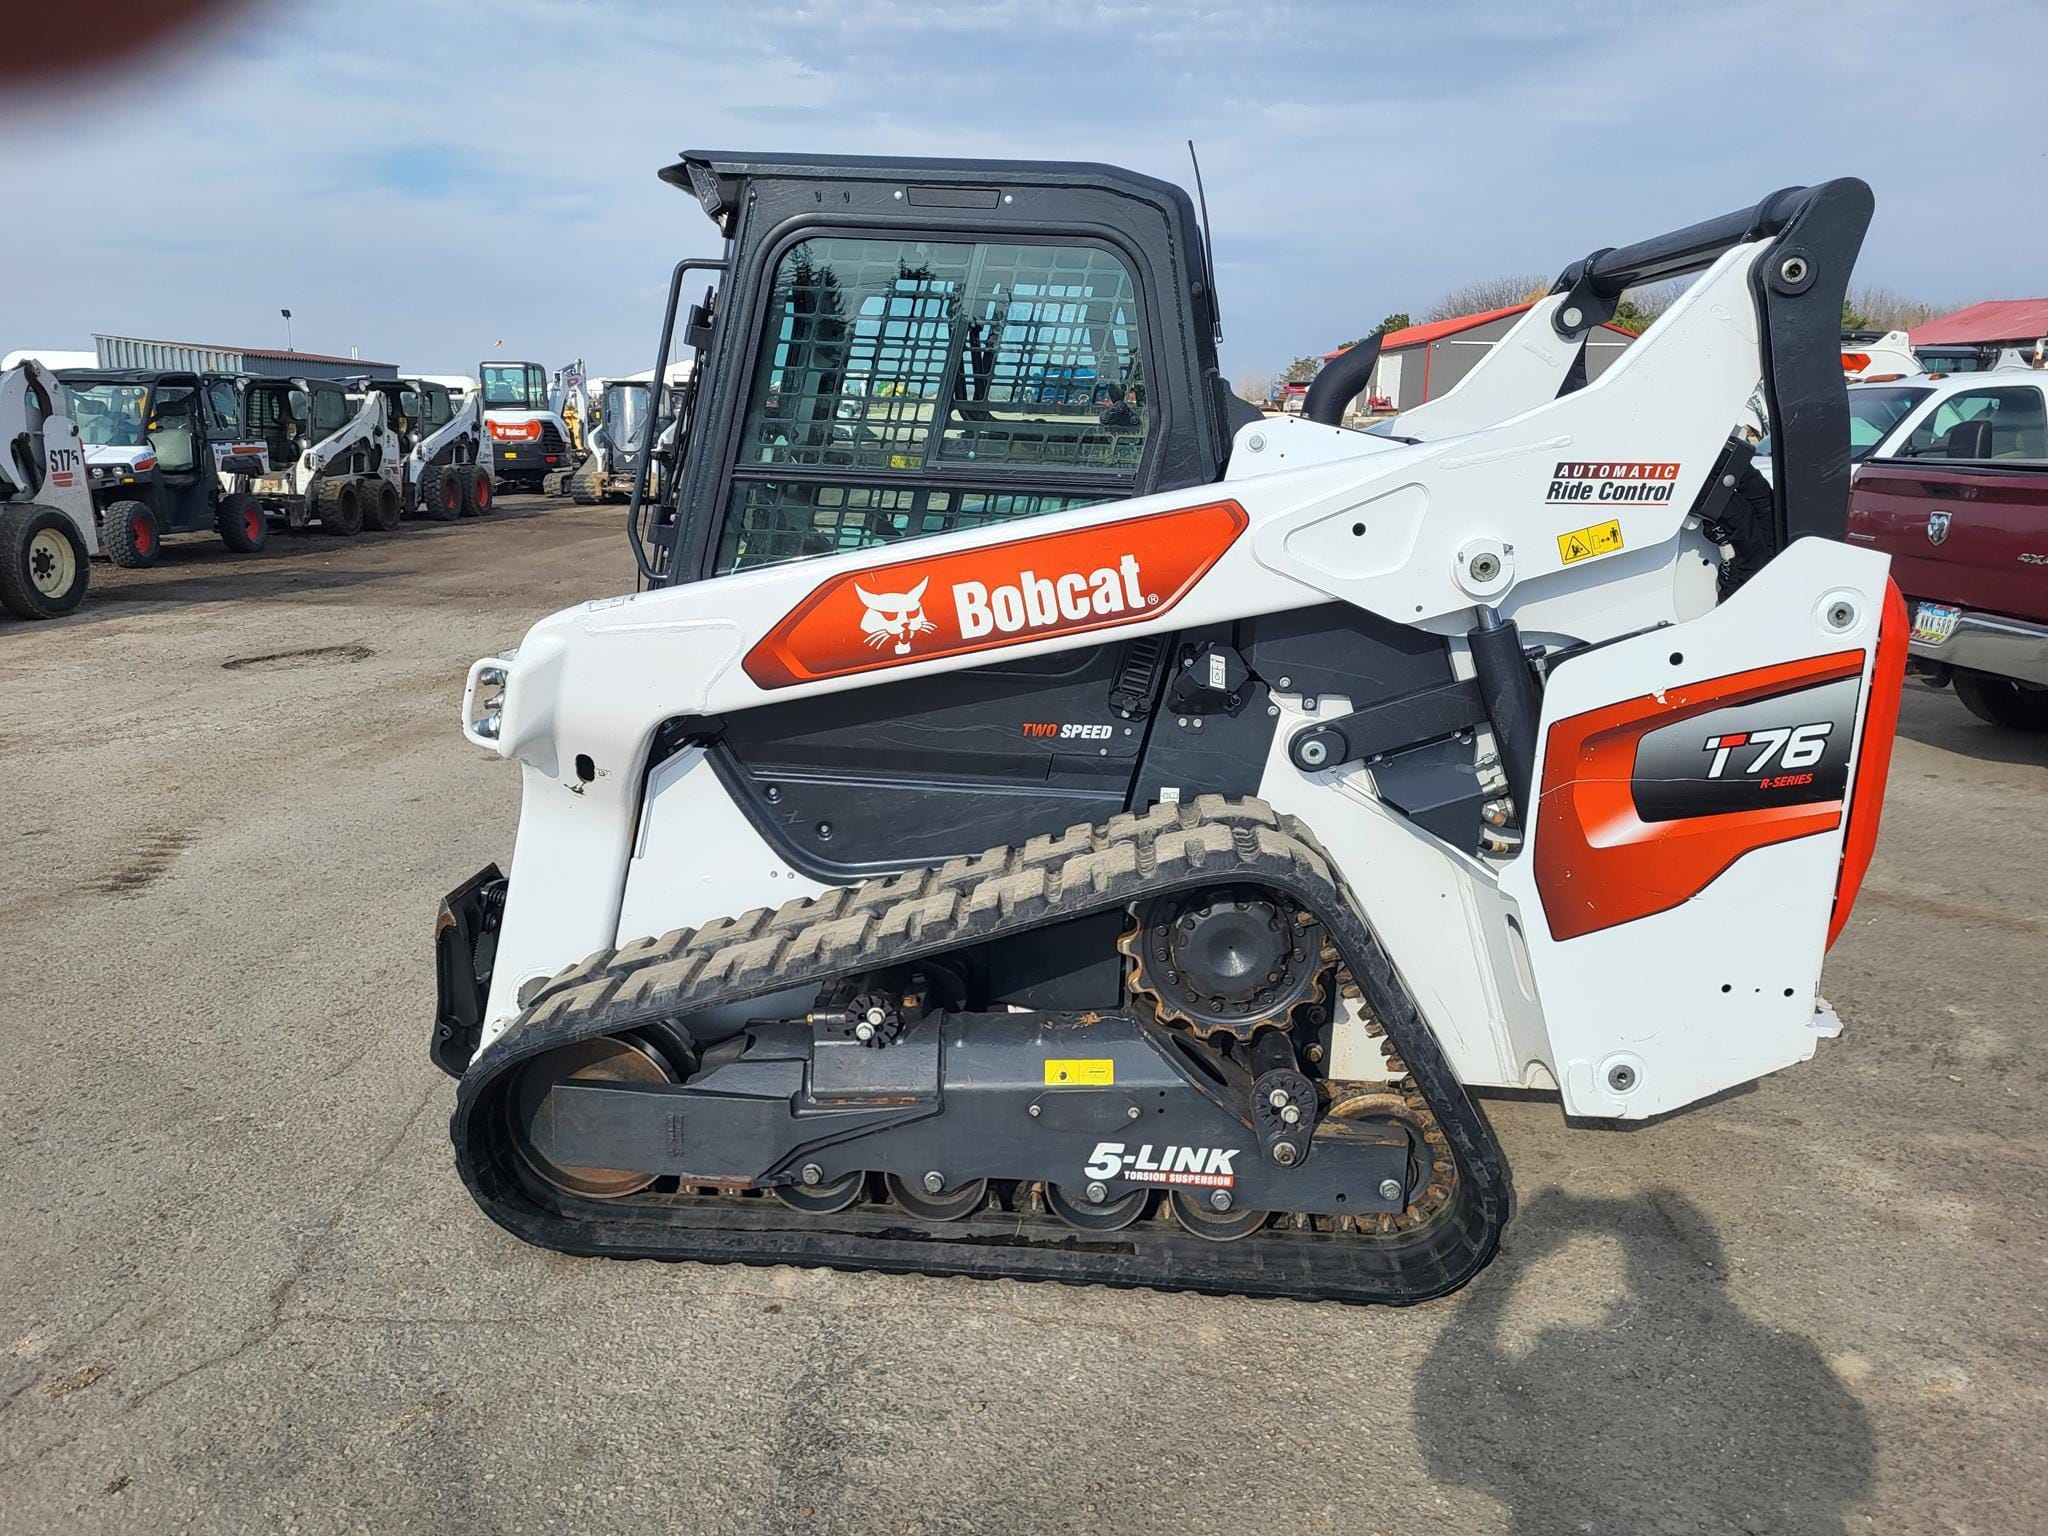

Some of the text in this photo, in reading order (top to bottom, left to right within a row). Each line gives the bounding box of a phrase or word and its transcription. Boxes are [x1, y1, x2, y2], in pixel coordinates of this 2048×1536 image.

[1558, 464, 1676, 478] AUTOMATIC
[1546, 481, 1675, 501] Ride Control
[951, 554, 1146, 640] Bobcat
[1022, 723, 1113, 739] TWO SPEED
[1703, 721, 1834, 779] T76
[1760, 773, 1814, 790] R-SERIES
[1084, 1142, 1241, 1180] 5-LINK
[1123, 1170, 1231, 1187] TORSION SUSPENSION
